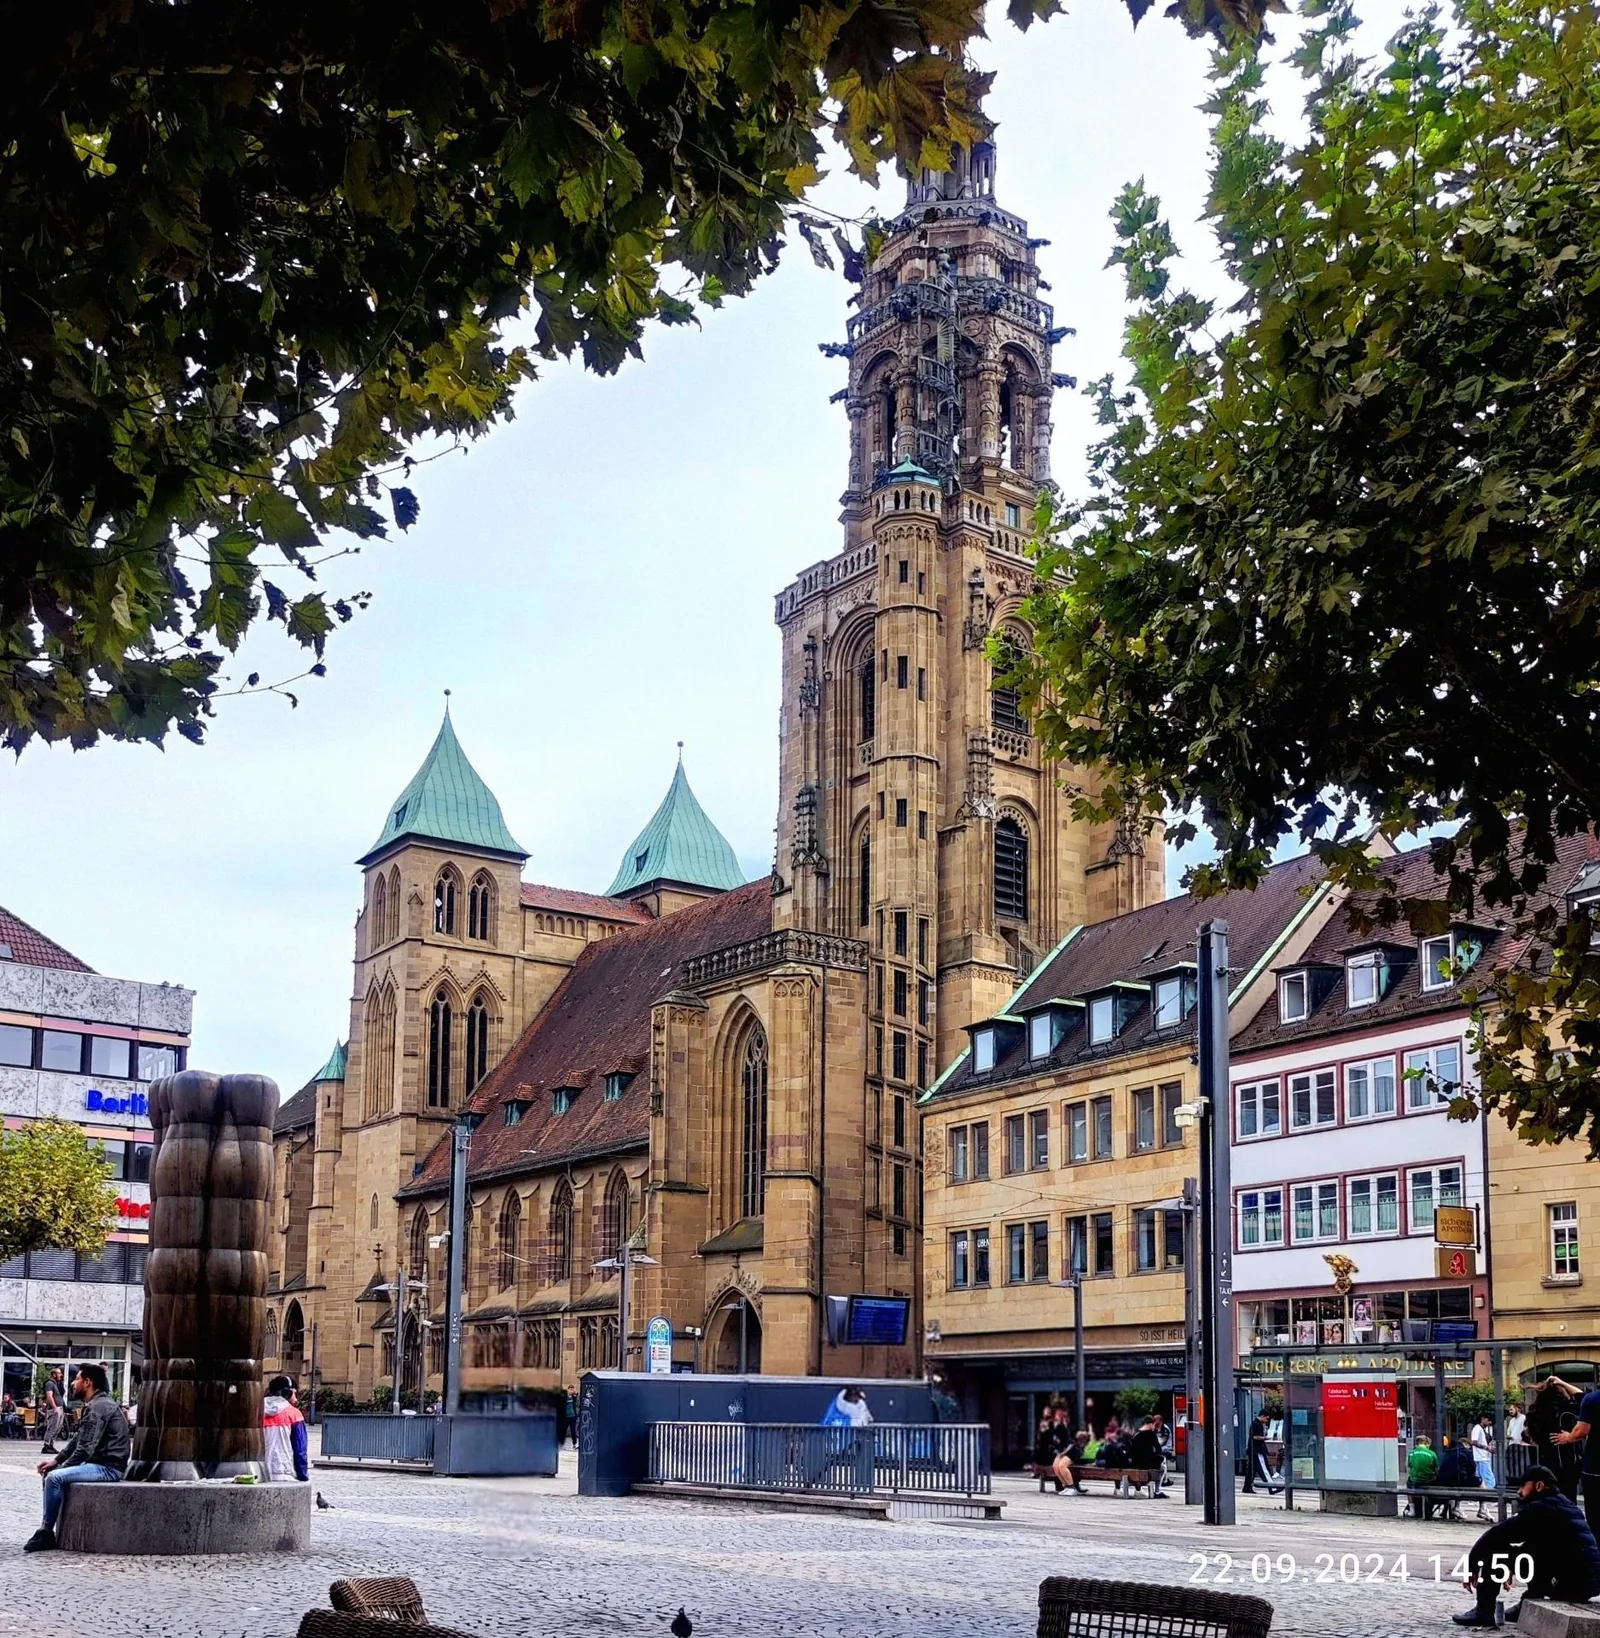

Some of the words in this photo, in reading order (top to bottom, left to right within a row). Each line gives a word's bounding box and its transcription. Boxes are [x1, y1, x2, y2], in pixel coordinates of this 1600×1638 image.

[87, 1089, 149, 1116] Berli
[1219, 1286, 1232, 1296] TAXI
[1139, 1330, 1149, 1341] SO
[1151, 1329, 1165, 1341] ISST
[1167, 1328, 1187, 1340] HEIL
